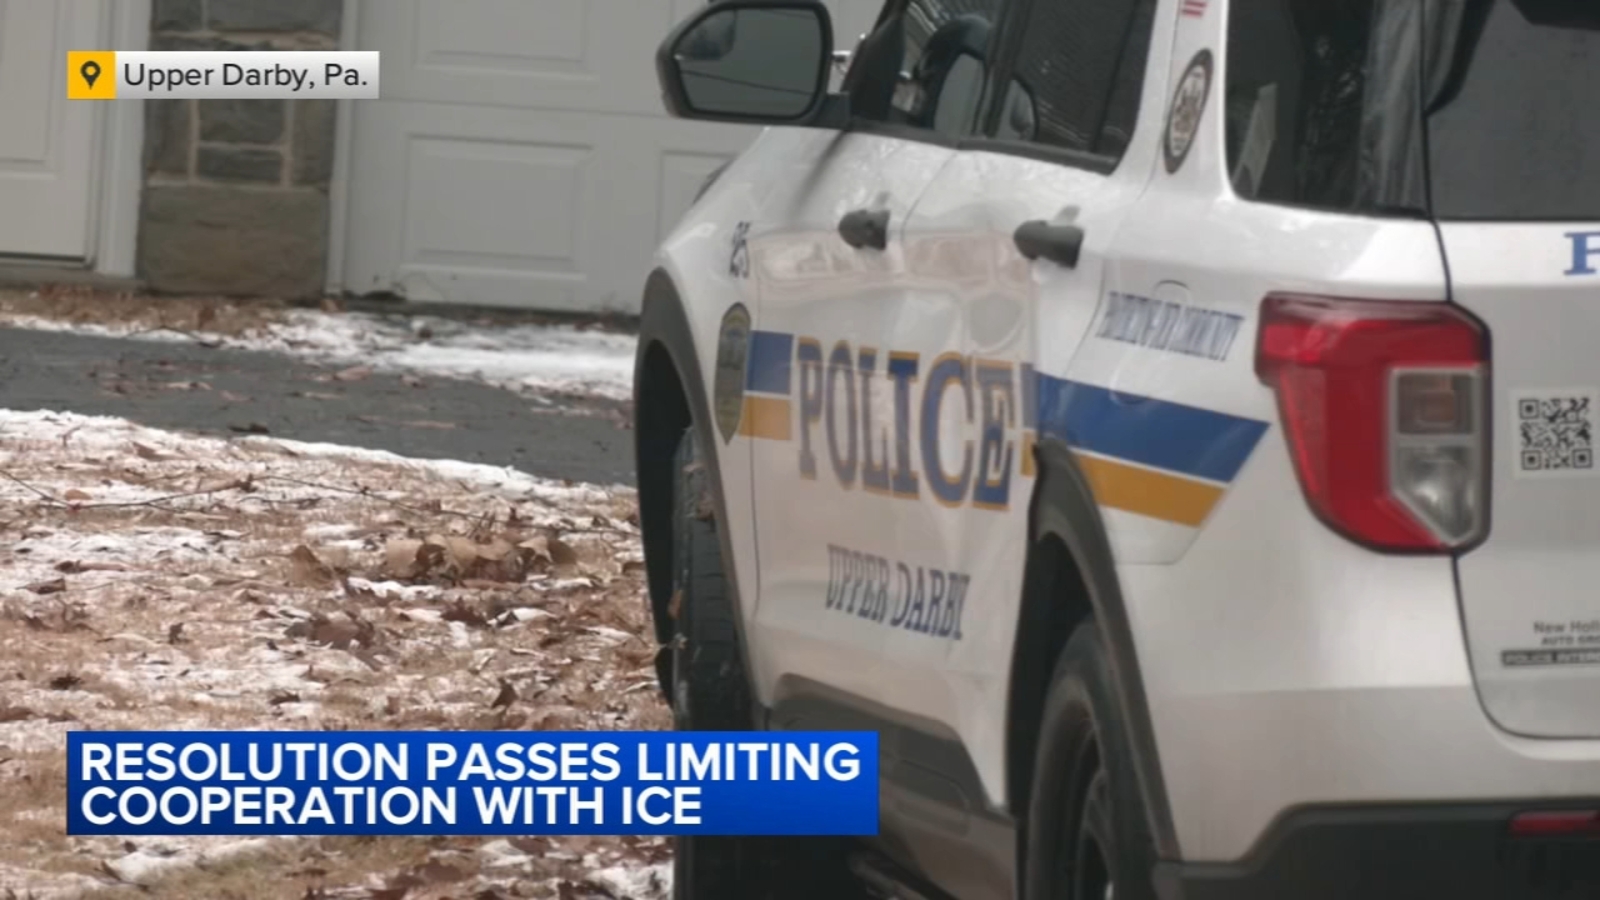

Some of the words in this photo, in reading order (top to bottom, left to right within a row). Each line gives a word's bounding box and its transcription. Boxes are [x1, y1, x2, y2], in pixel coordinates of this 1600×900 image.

[797, 335, 1014, 512] POLICE
[825, 543, 890, 624] UPPER
[890, 561, 971, 641] DARBY
[1533, 621, 1565, 633] New
